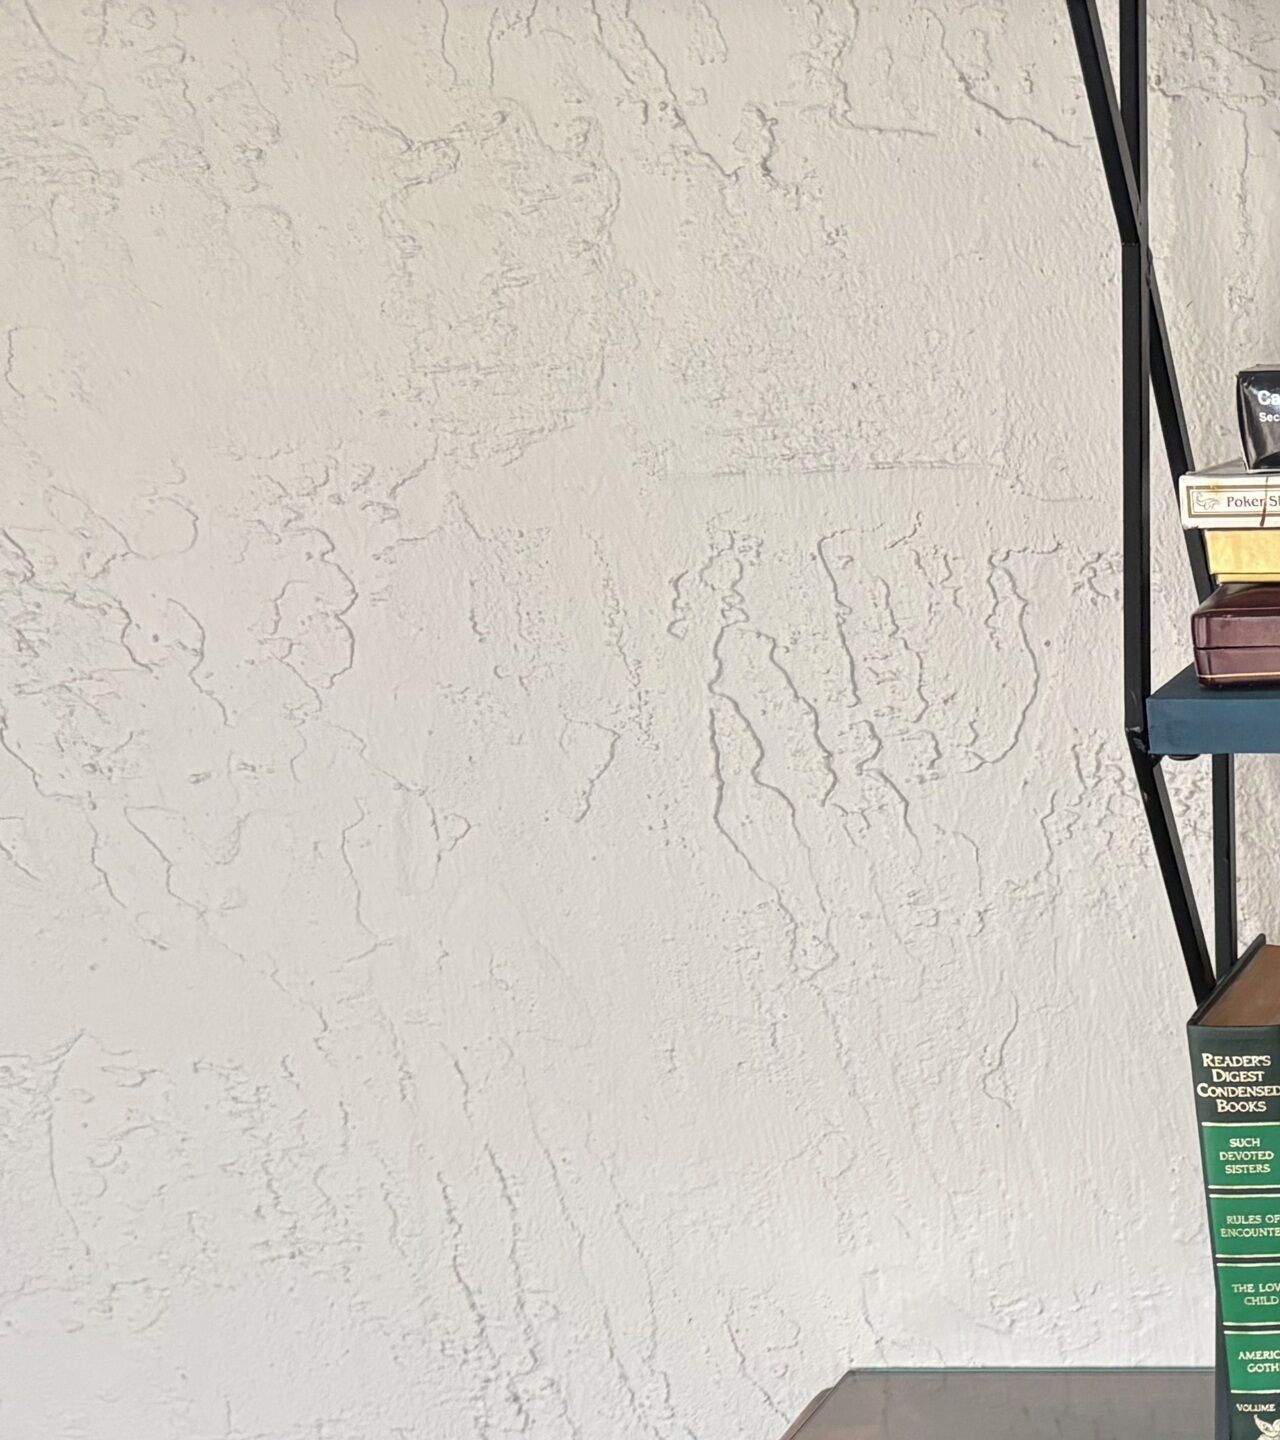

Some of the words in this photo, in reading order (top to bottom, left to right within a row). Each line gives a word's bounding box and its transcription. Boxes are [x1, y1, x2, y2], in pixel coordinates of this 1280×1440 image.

[1202, 1053, 1271, 1067] READER'S
[1212, 1069, 1265, 1082] DIGEST
[1216, 1099, 1267, 1113] BOOKS
[1229, 1138, 1261, 1148] SUCH
[1219, 1152, 1274, 1161] DEVOTED
[1225, 1164, 1271, 1174] SISTERS
[1226, 1215, 1261, 1224] RULES
[1265, 1215, 1280, 1223] OF
[1232, 1284, 1256, 1292] THE
[1244, 1296, 1279, 1305] CHILD
